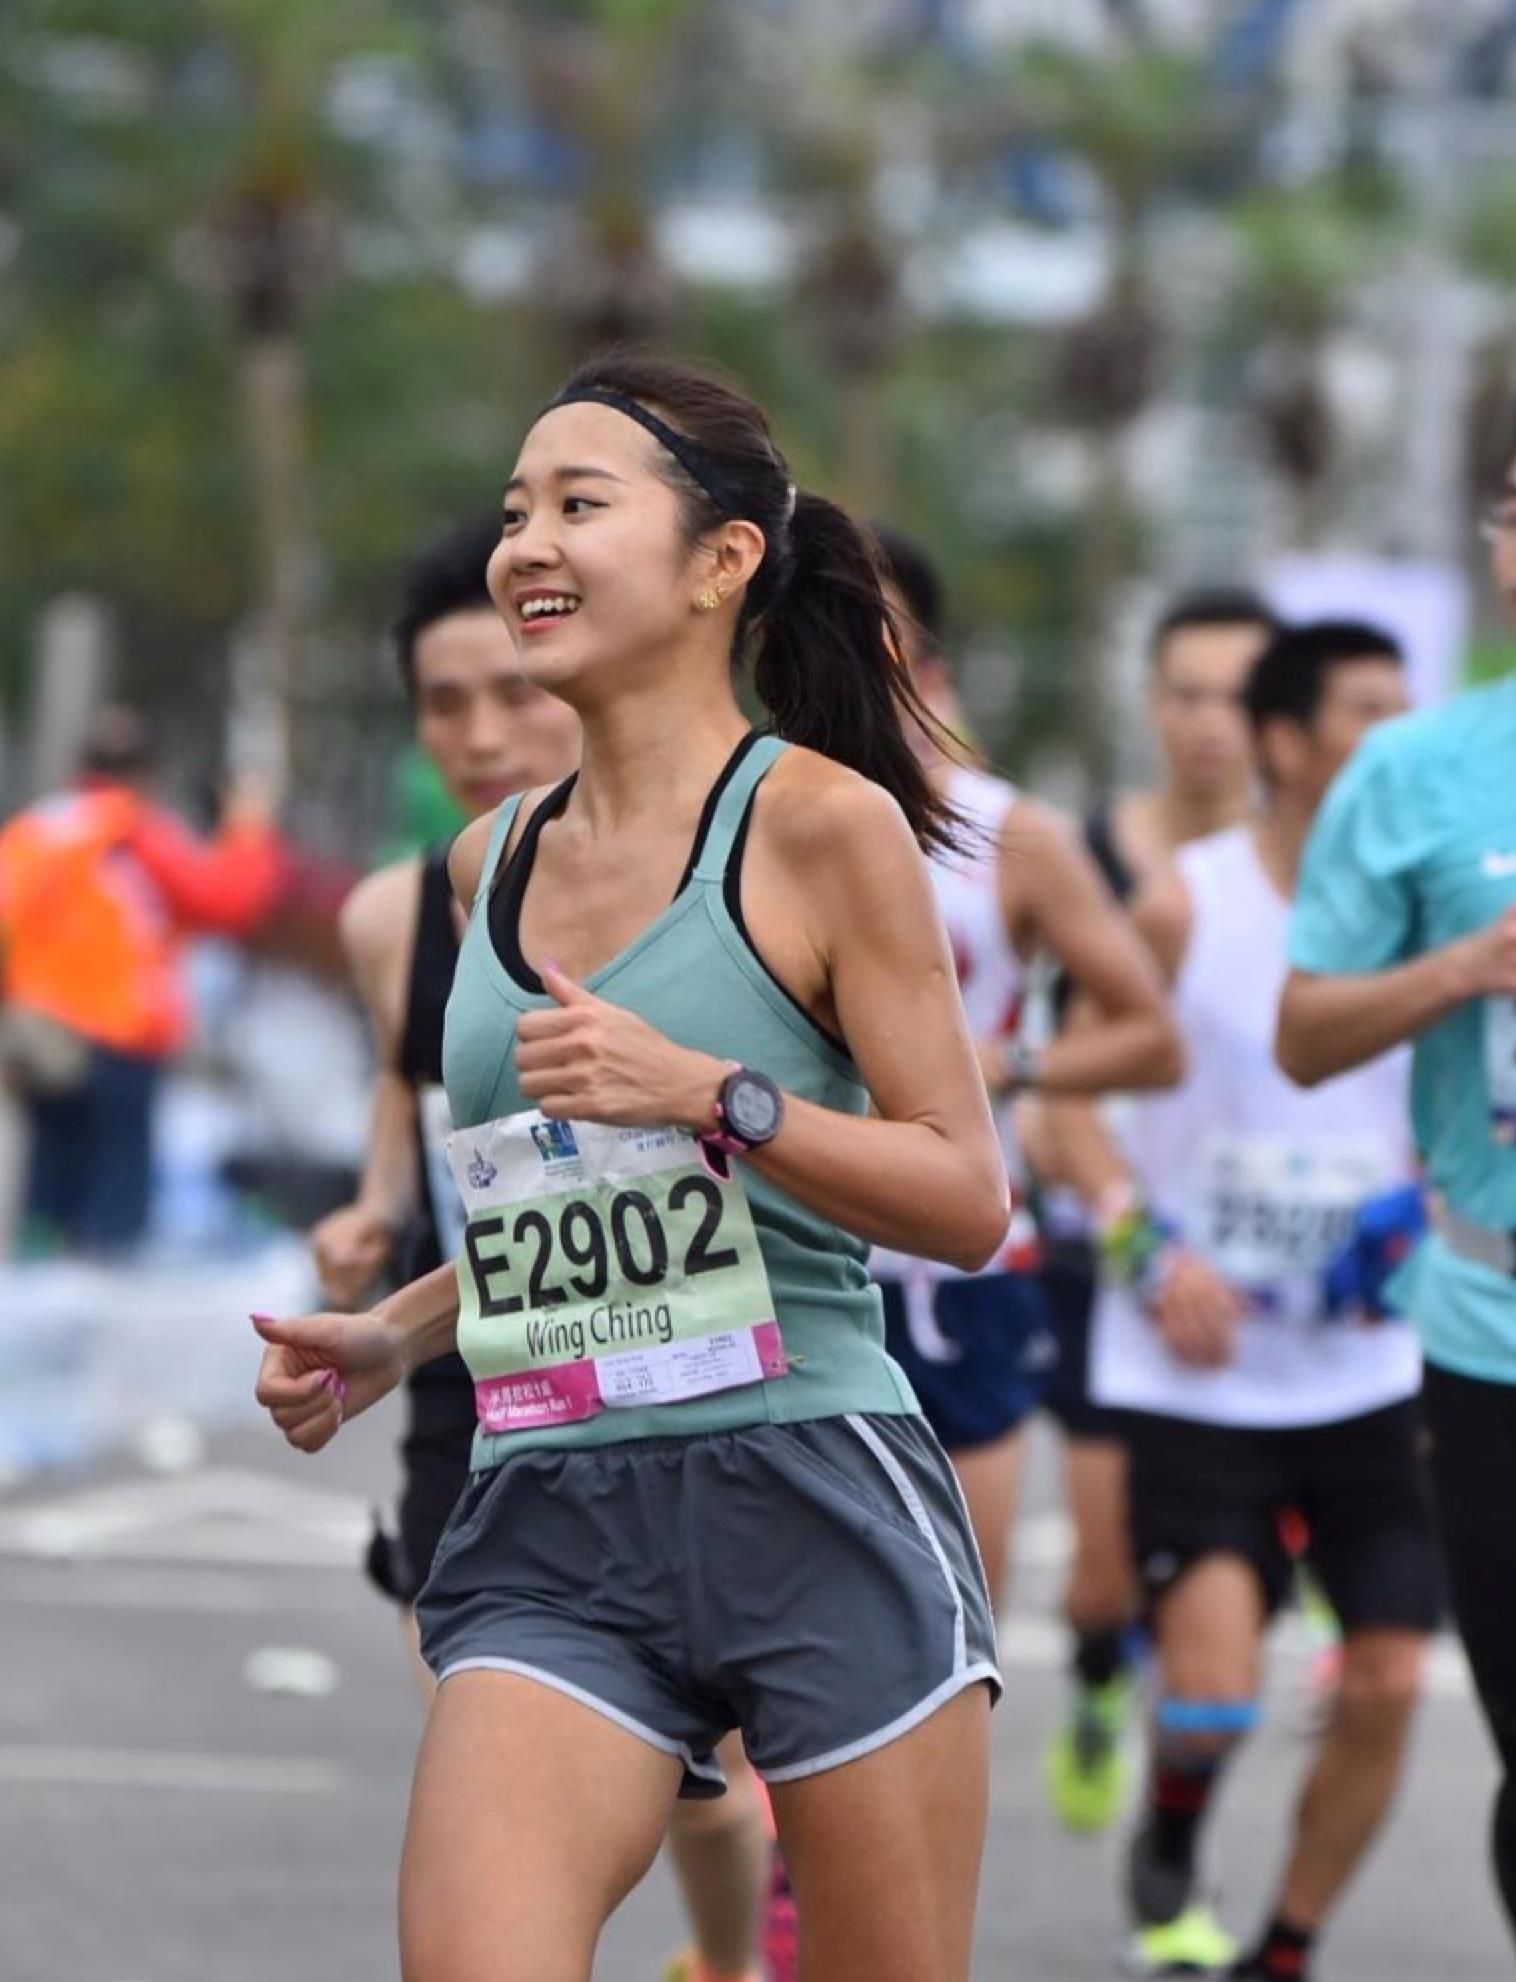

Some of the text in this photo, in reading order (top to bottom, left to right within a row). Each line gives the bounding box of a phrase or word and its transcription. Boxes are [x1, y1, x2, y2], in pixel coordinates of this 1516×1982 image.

[464, 1175, 739, 1319] E2902
[526, 1318, 586, 1359] Wing
[590, 1301, 674, 1344] Ching
